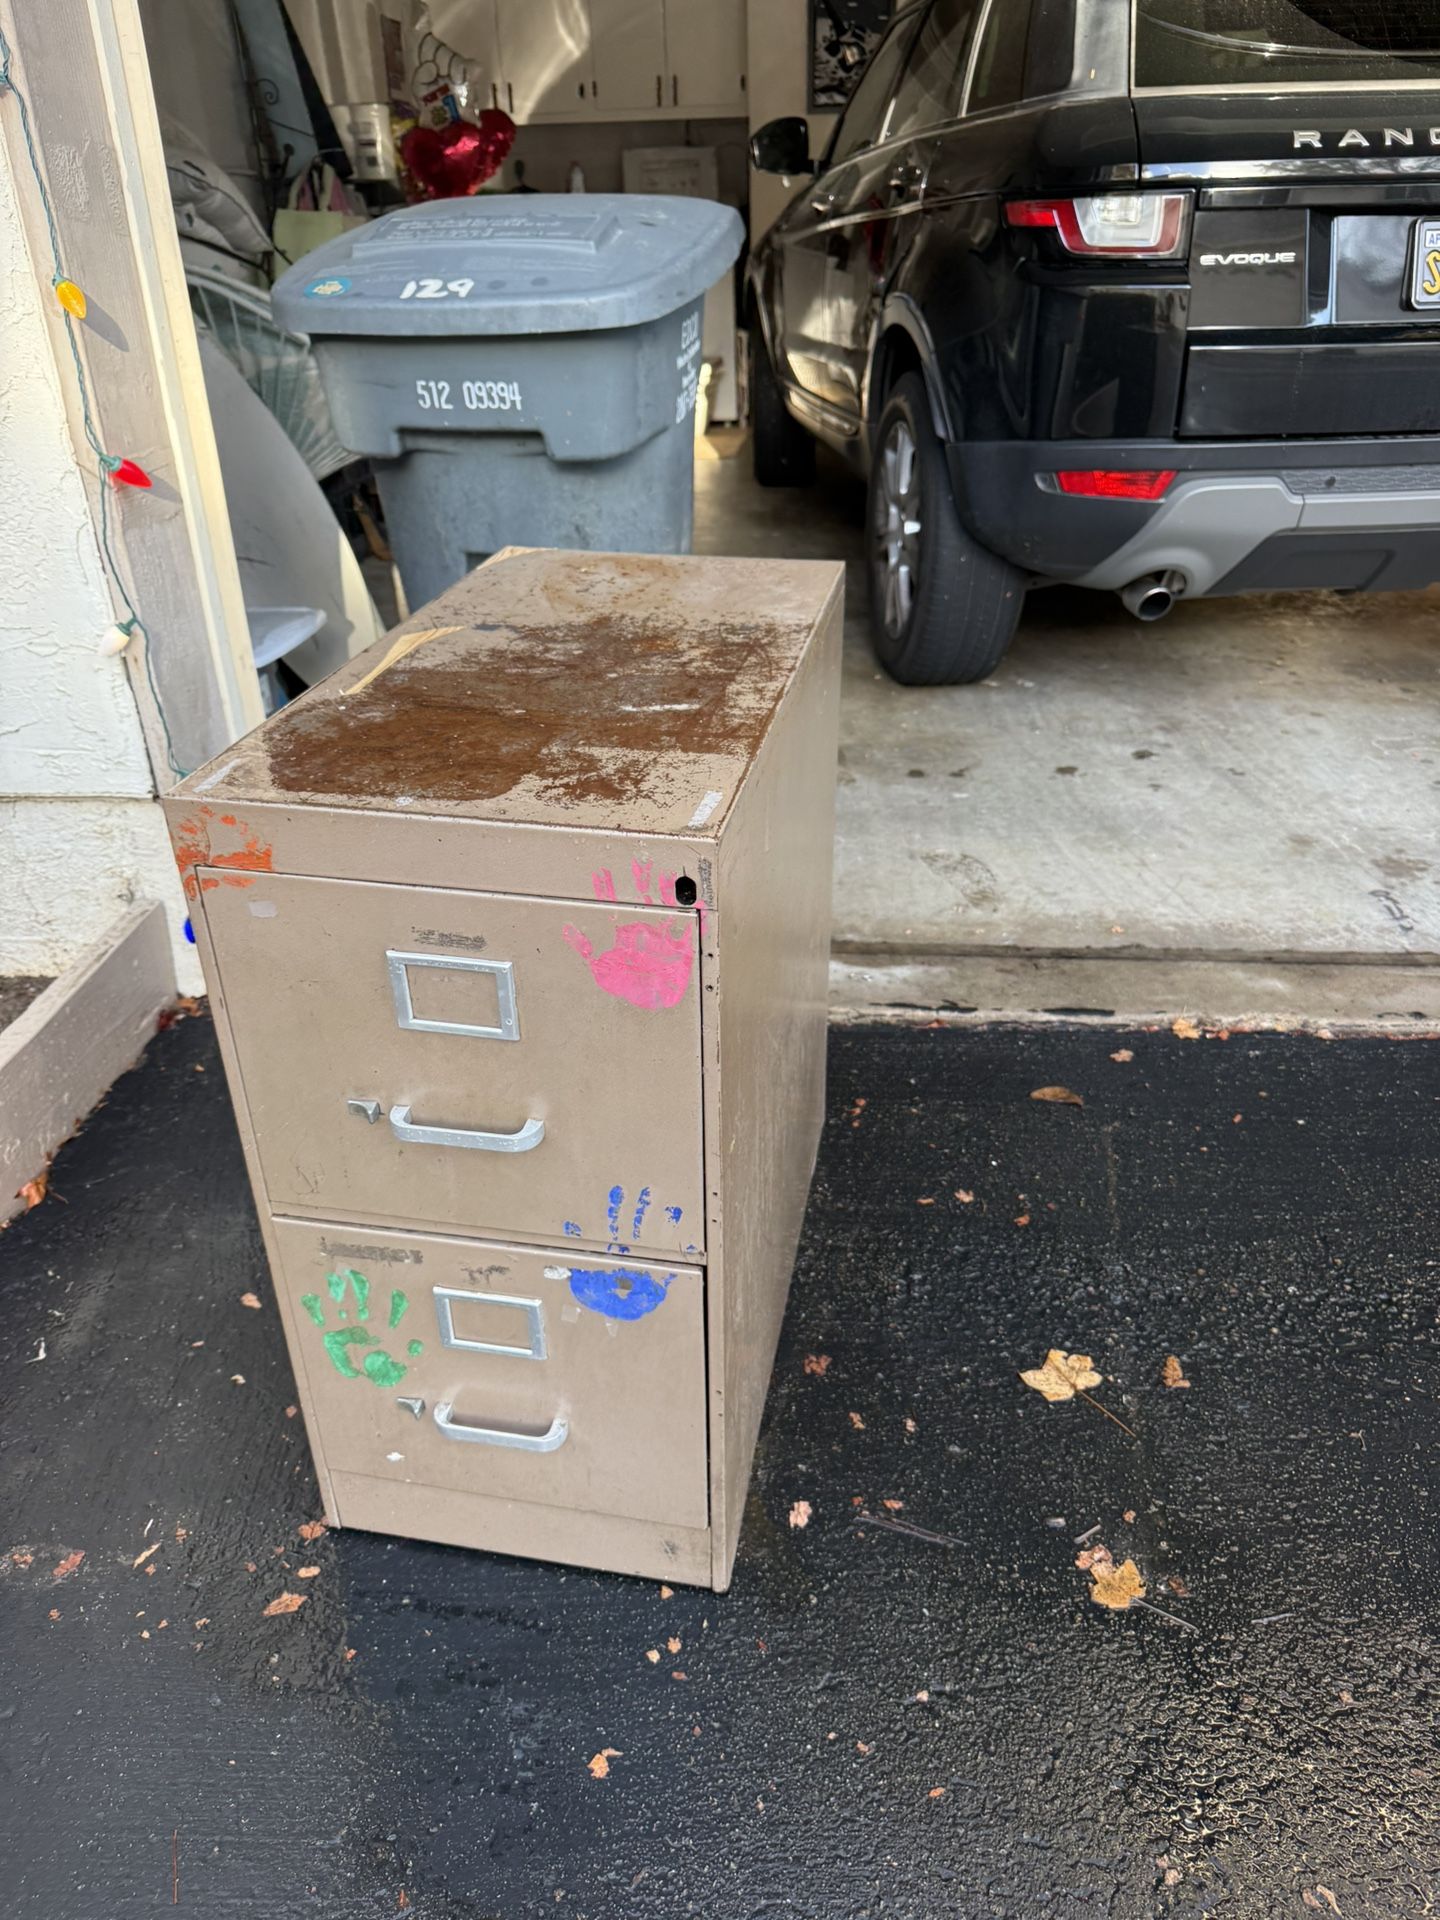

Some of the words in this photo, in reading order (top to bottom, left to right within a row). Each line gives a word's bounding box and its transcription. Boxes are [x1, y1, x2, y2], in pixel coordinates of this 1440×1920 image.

[1200, 251, 1297, 266] EVOQUE
[400, 278, 475, 299] 129
[416, 379, 453, 410] 512
[463, 381, 523, 411] 09394
